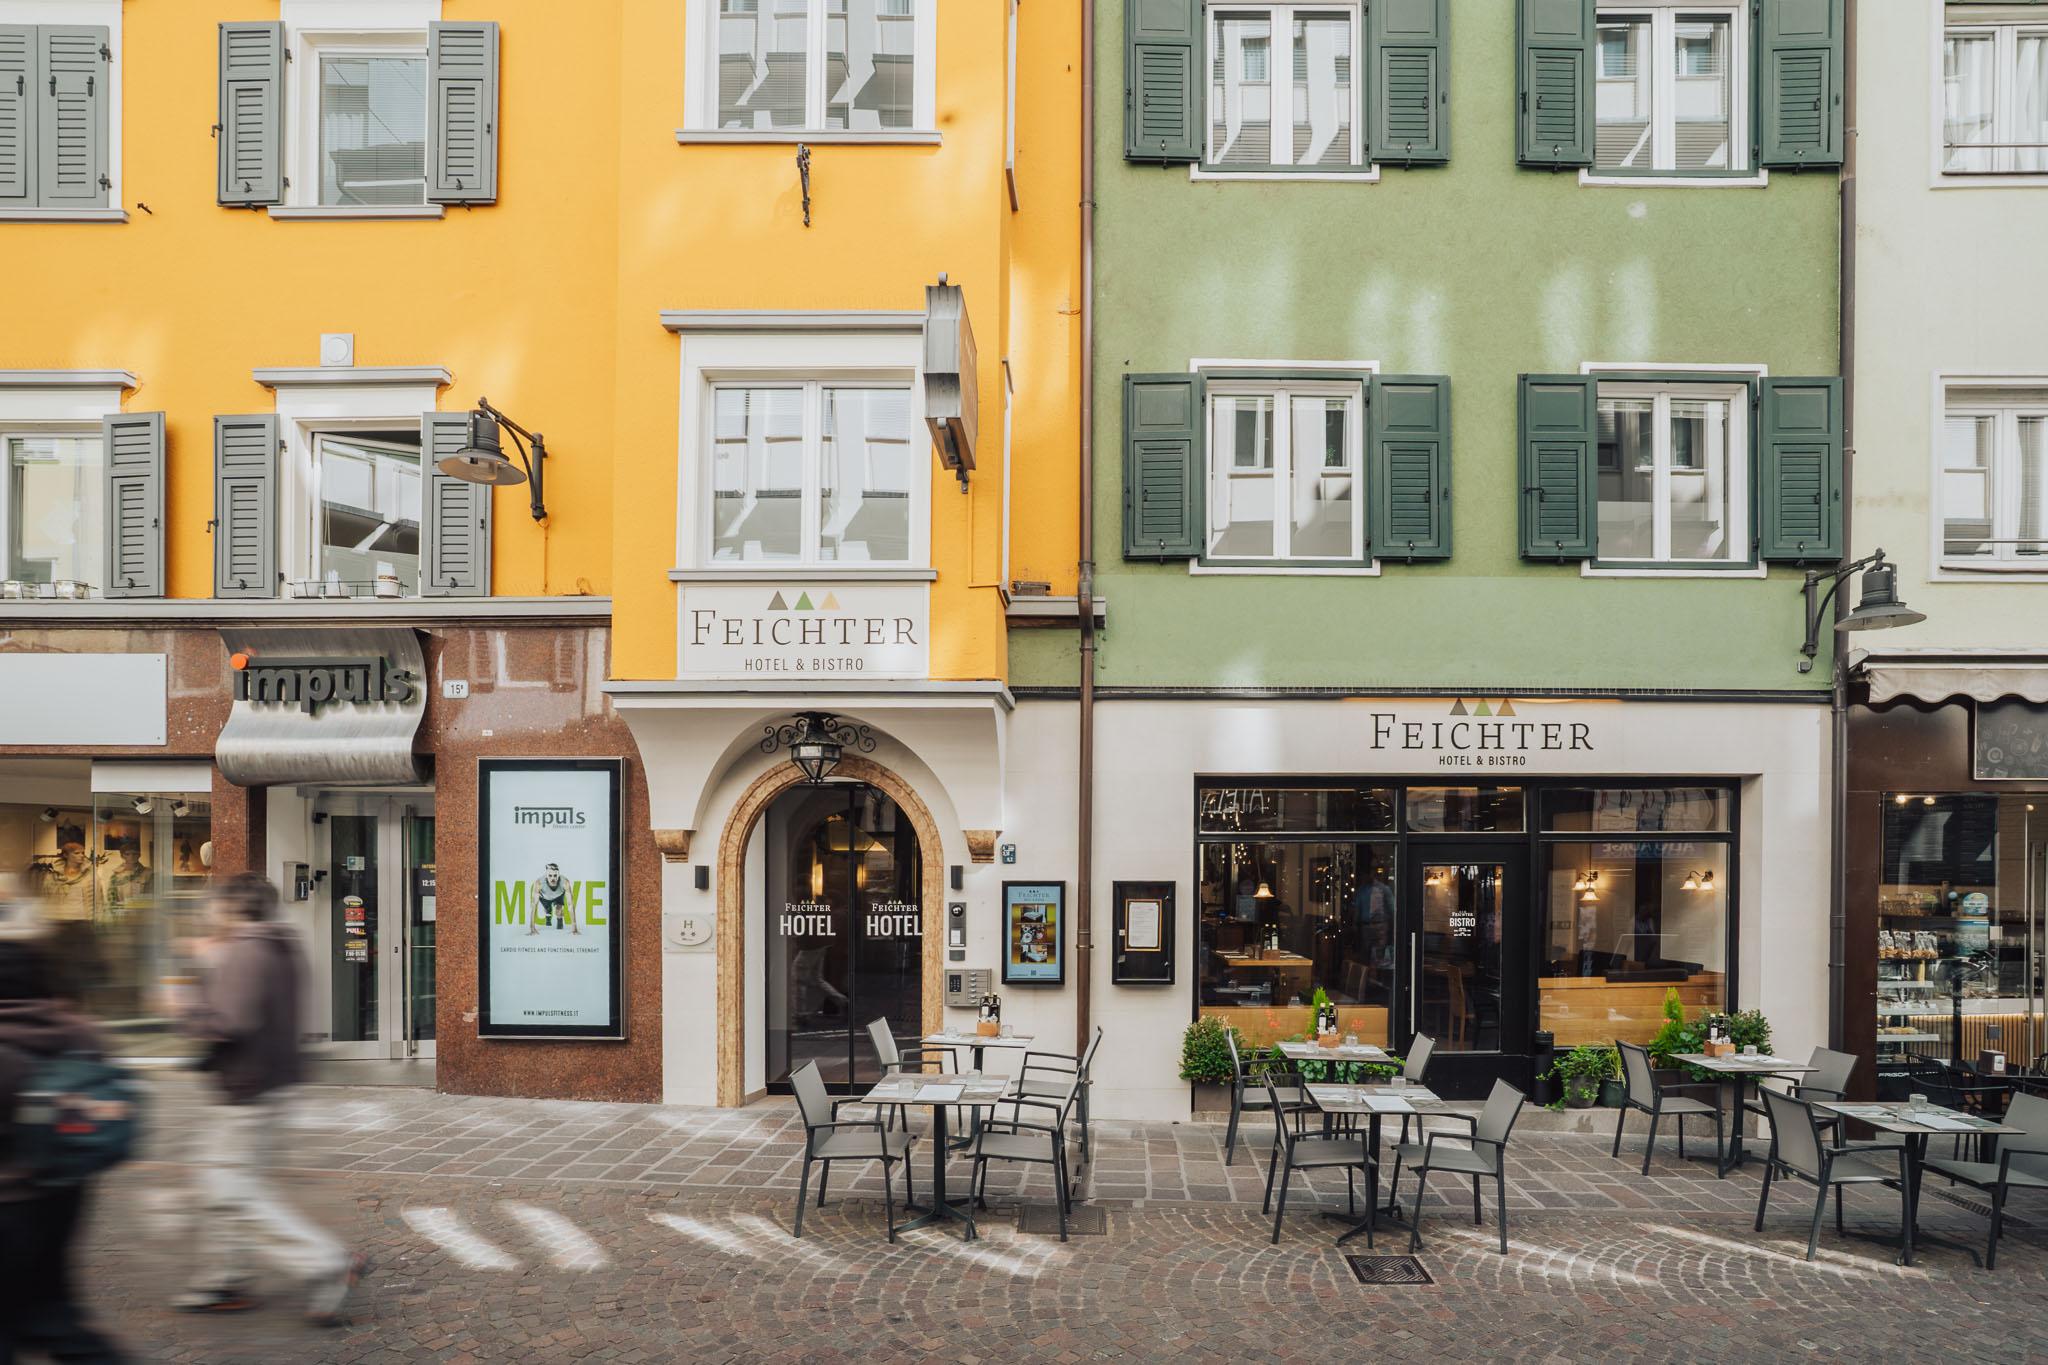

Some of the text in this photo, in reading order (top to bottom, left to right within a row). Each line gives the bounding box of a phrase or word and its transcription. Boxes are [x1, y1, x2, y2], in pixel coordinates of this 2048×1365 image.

[690, 610, 918, 645] FEICHTER
[745, 658, 863, 670] HOTEL & BISTRO
[230, 653, 412, 714] impuls
[1370, 713, 1594, 750] FEICHTER
[1439, 755, 1526, 766] HOTEL & BISTRO
[514, 806, 586, 828] impuls
[785, 903, 831, 912] FEICHTER
[872, 903, 918, 912] FEICHTER
[780, 915, 836, 936] HOTEL
[866, 915, 923, 936] HOTEL
[1449, 917, 1476, 927] BISTRO
